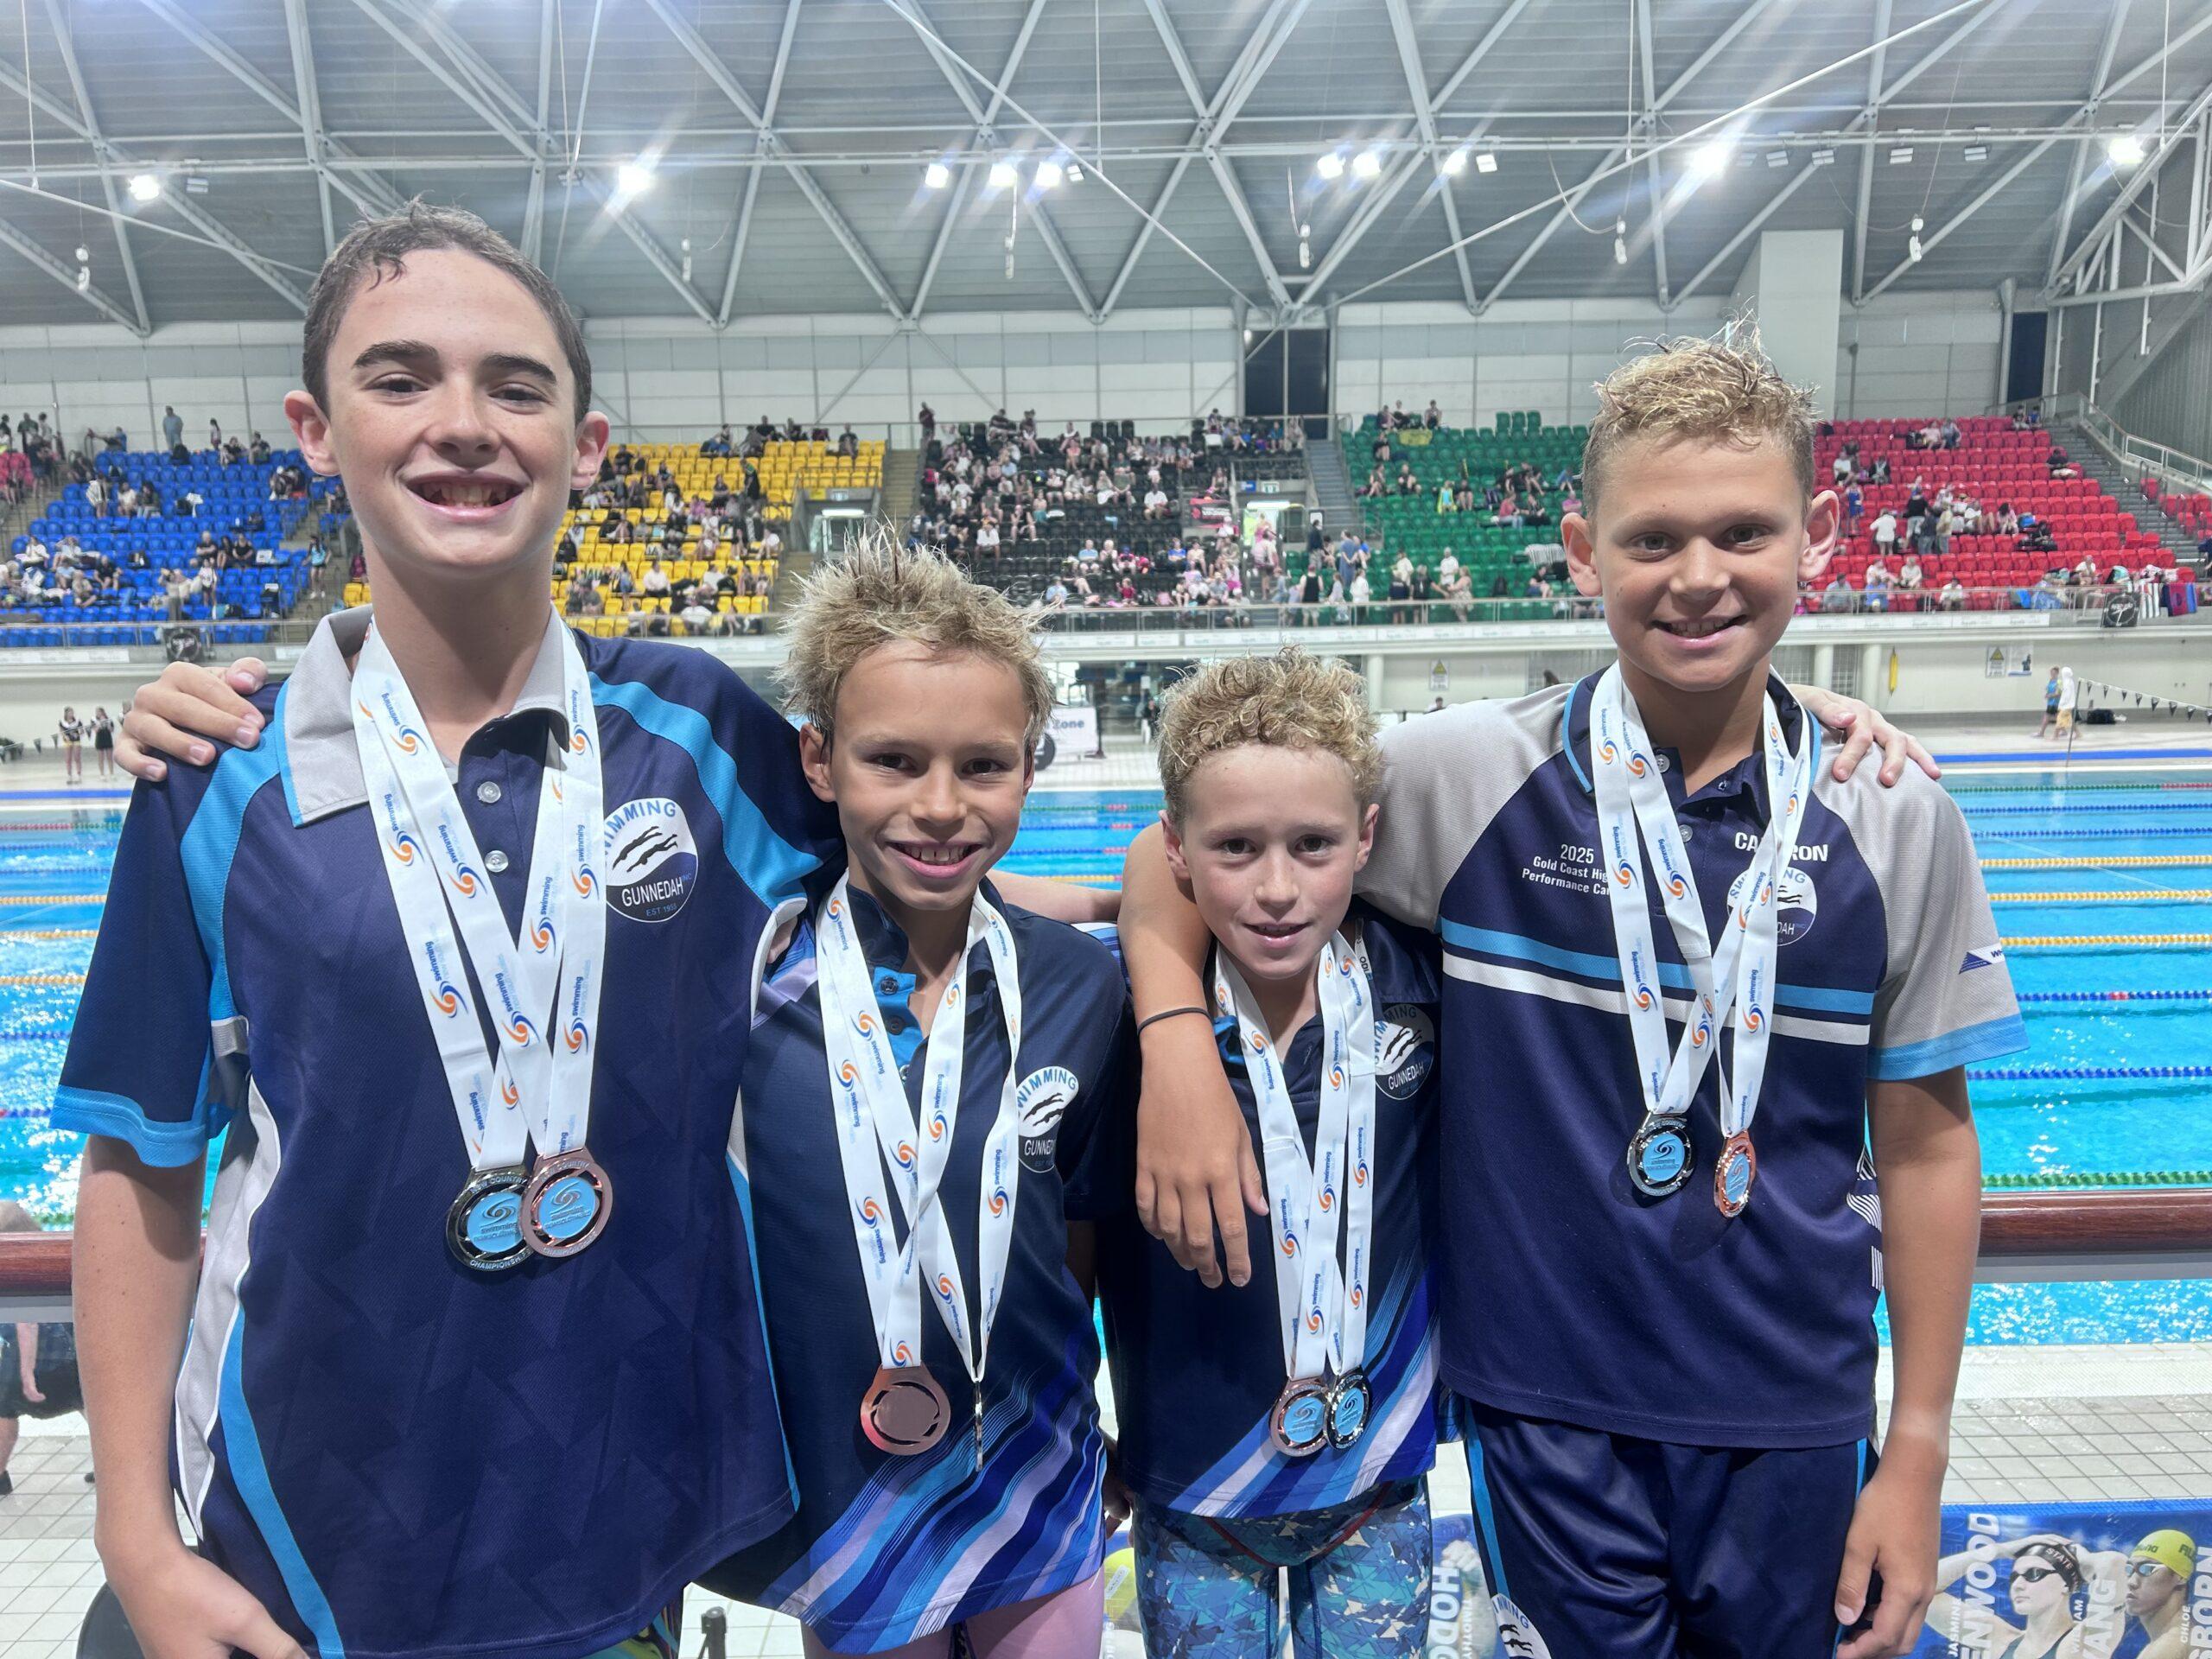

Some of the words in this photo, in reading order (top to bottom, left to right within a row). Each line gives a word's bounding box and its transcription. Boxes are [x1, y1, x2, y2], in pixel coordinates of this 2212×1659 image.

[605, 800, 677, 854] IMMING
[1560, 843, 1594, 864] 2025
[1734, 831, 1828, 861] CARON
[1522, 868, 1590, 893] Performance
[1533, 855, 1557, 871] Gold
[1560, 862, 1588, 878] Coast
[1592, 868, 1608, 883] Hig
[621, 876, 684, 907] GUNNEDAH
[1017, 1068, 1077, 1111] WIMMING
[1388, 1061, 1424, 1090] GUNNEDAH
[2046, 1548, 2074, 1569] STATE
[1948, 1599, 1962, 1658] JASMINE
[2179, 1605, 2191, 1643] CHLOE
